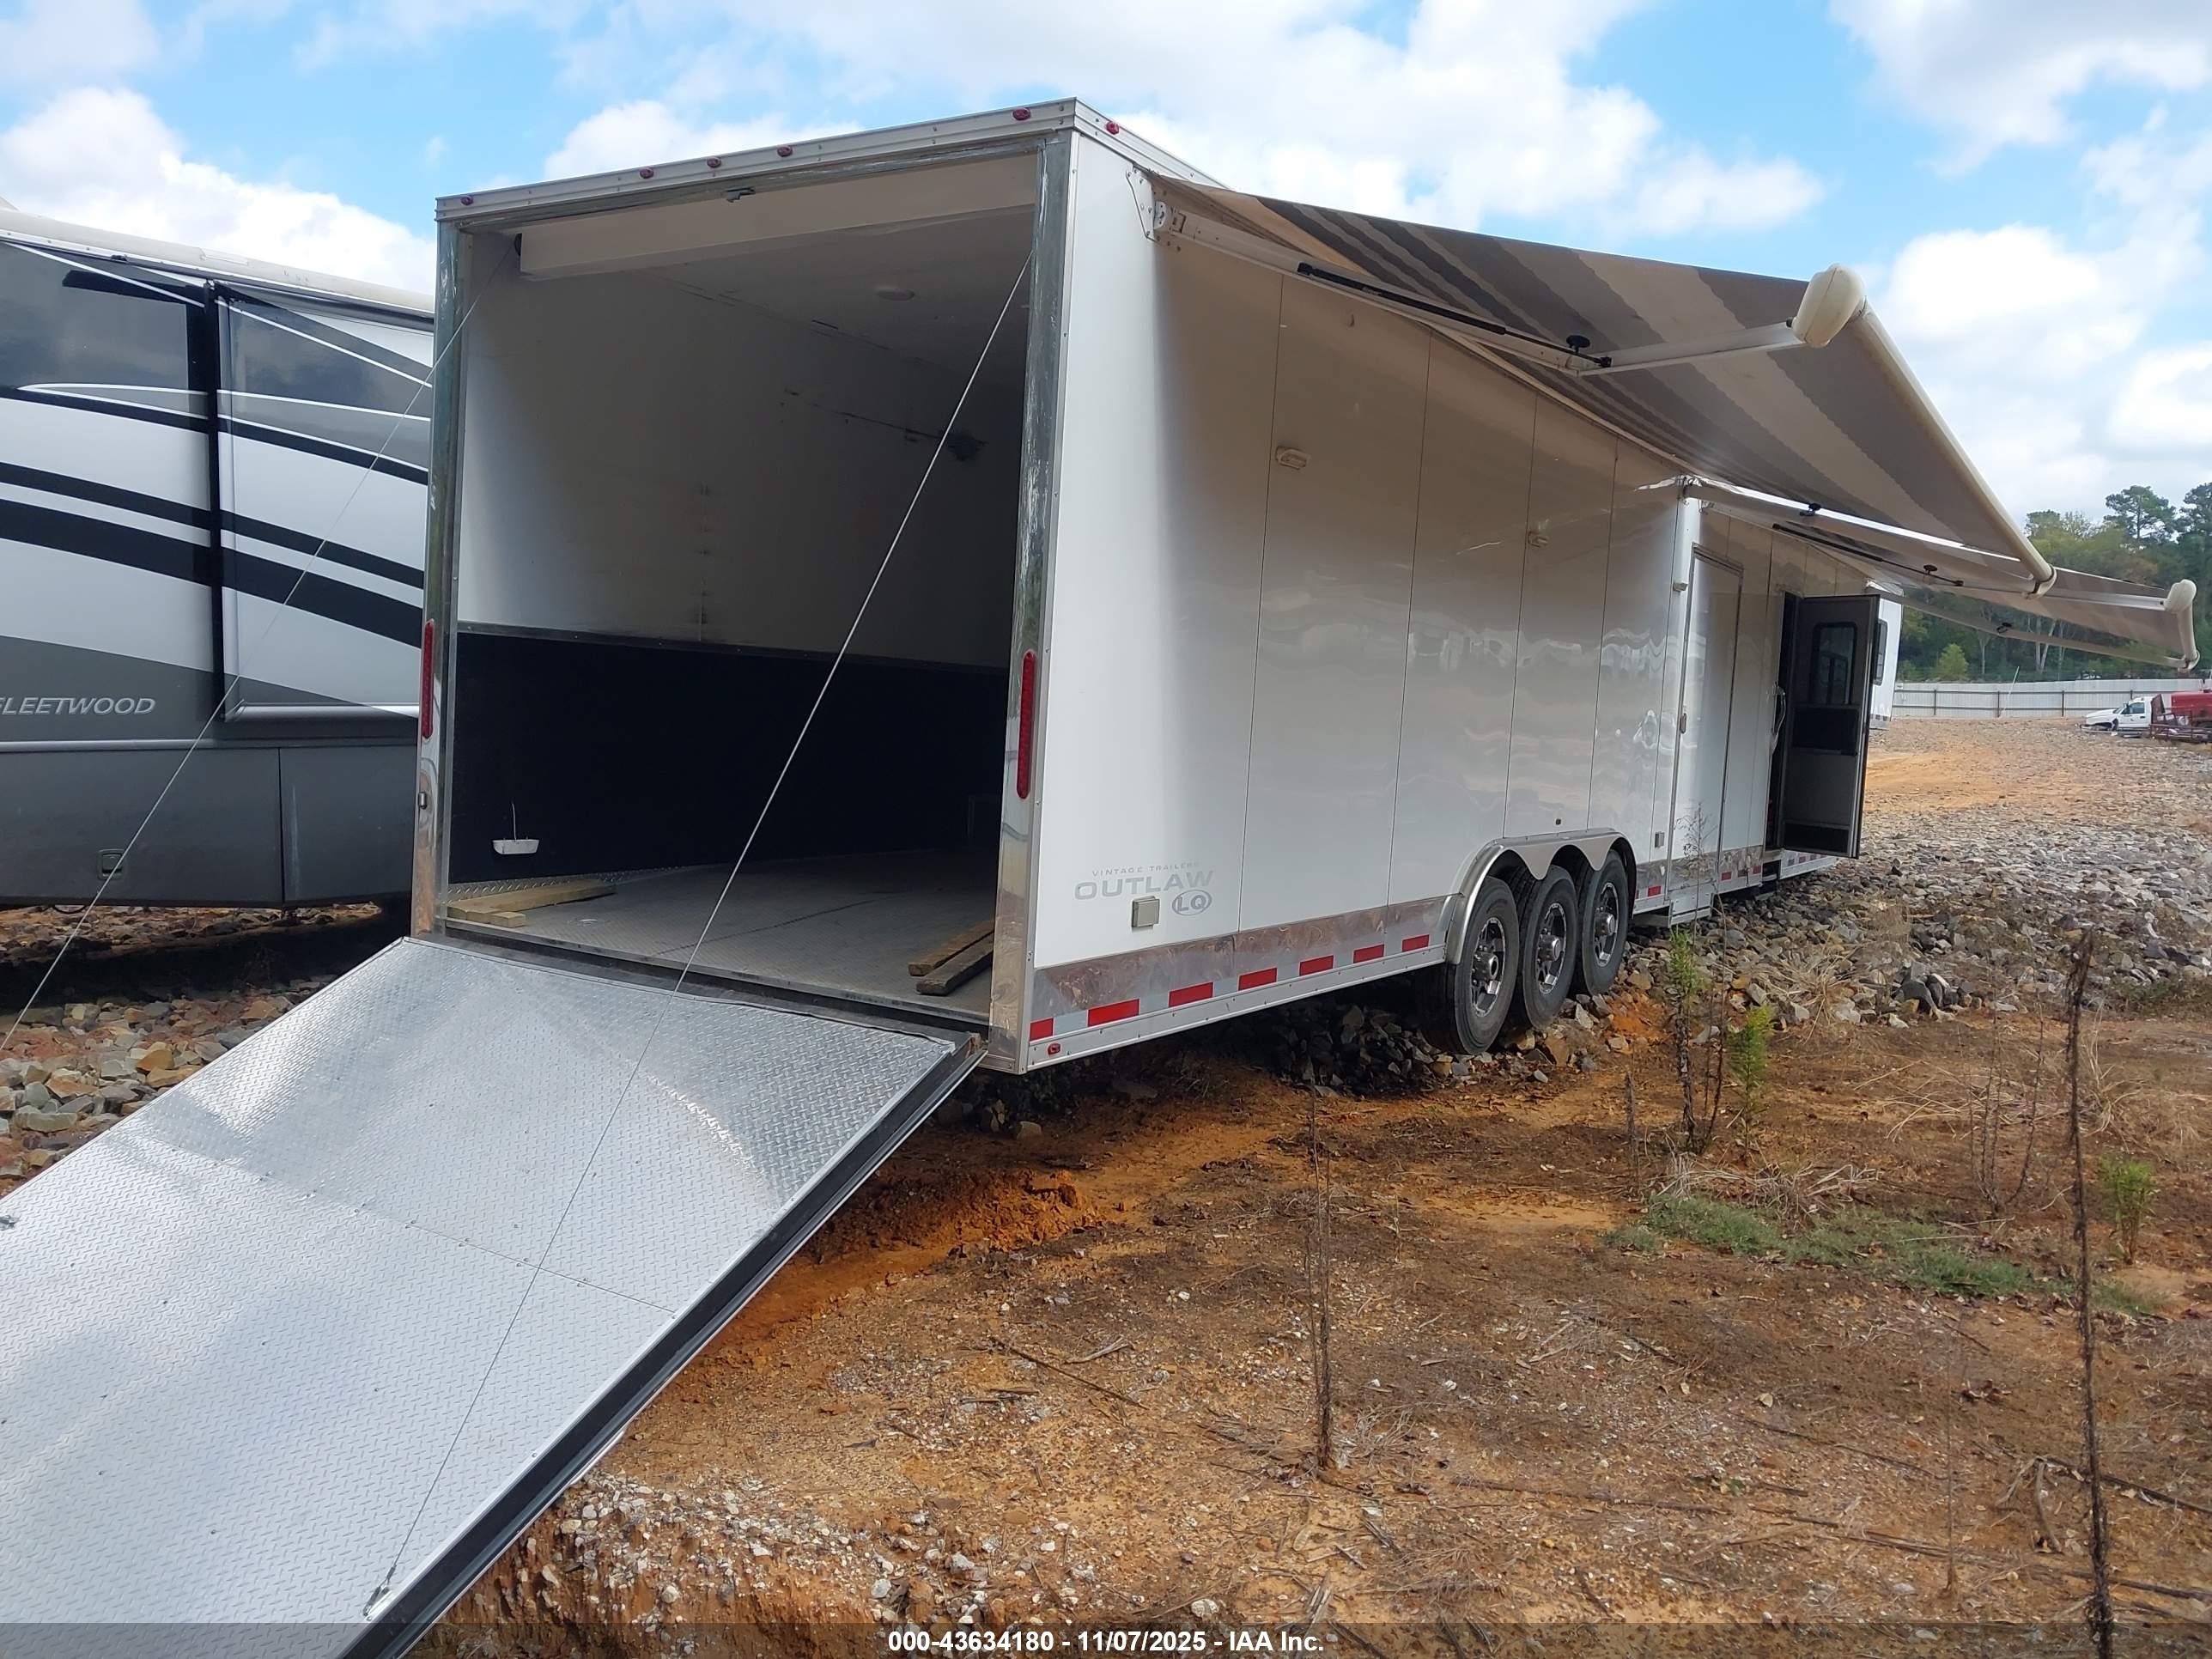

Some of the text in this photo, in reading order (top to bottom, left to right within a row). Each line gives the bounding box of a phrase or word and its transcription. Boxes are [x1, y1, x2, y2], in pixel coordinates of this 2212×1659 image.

[1091, 866, 1144, 877] VINTAGE
[1074, 870, 1214, 900] OUTLAW
[1176, 894, 1207, 913] LQ
